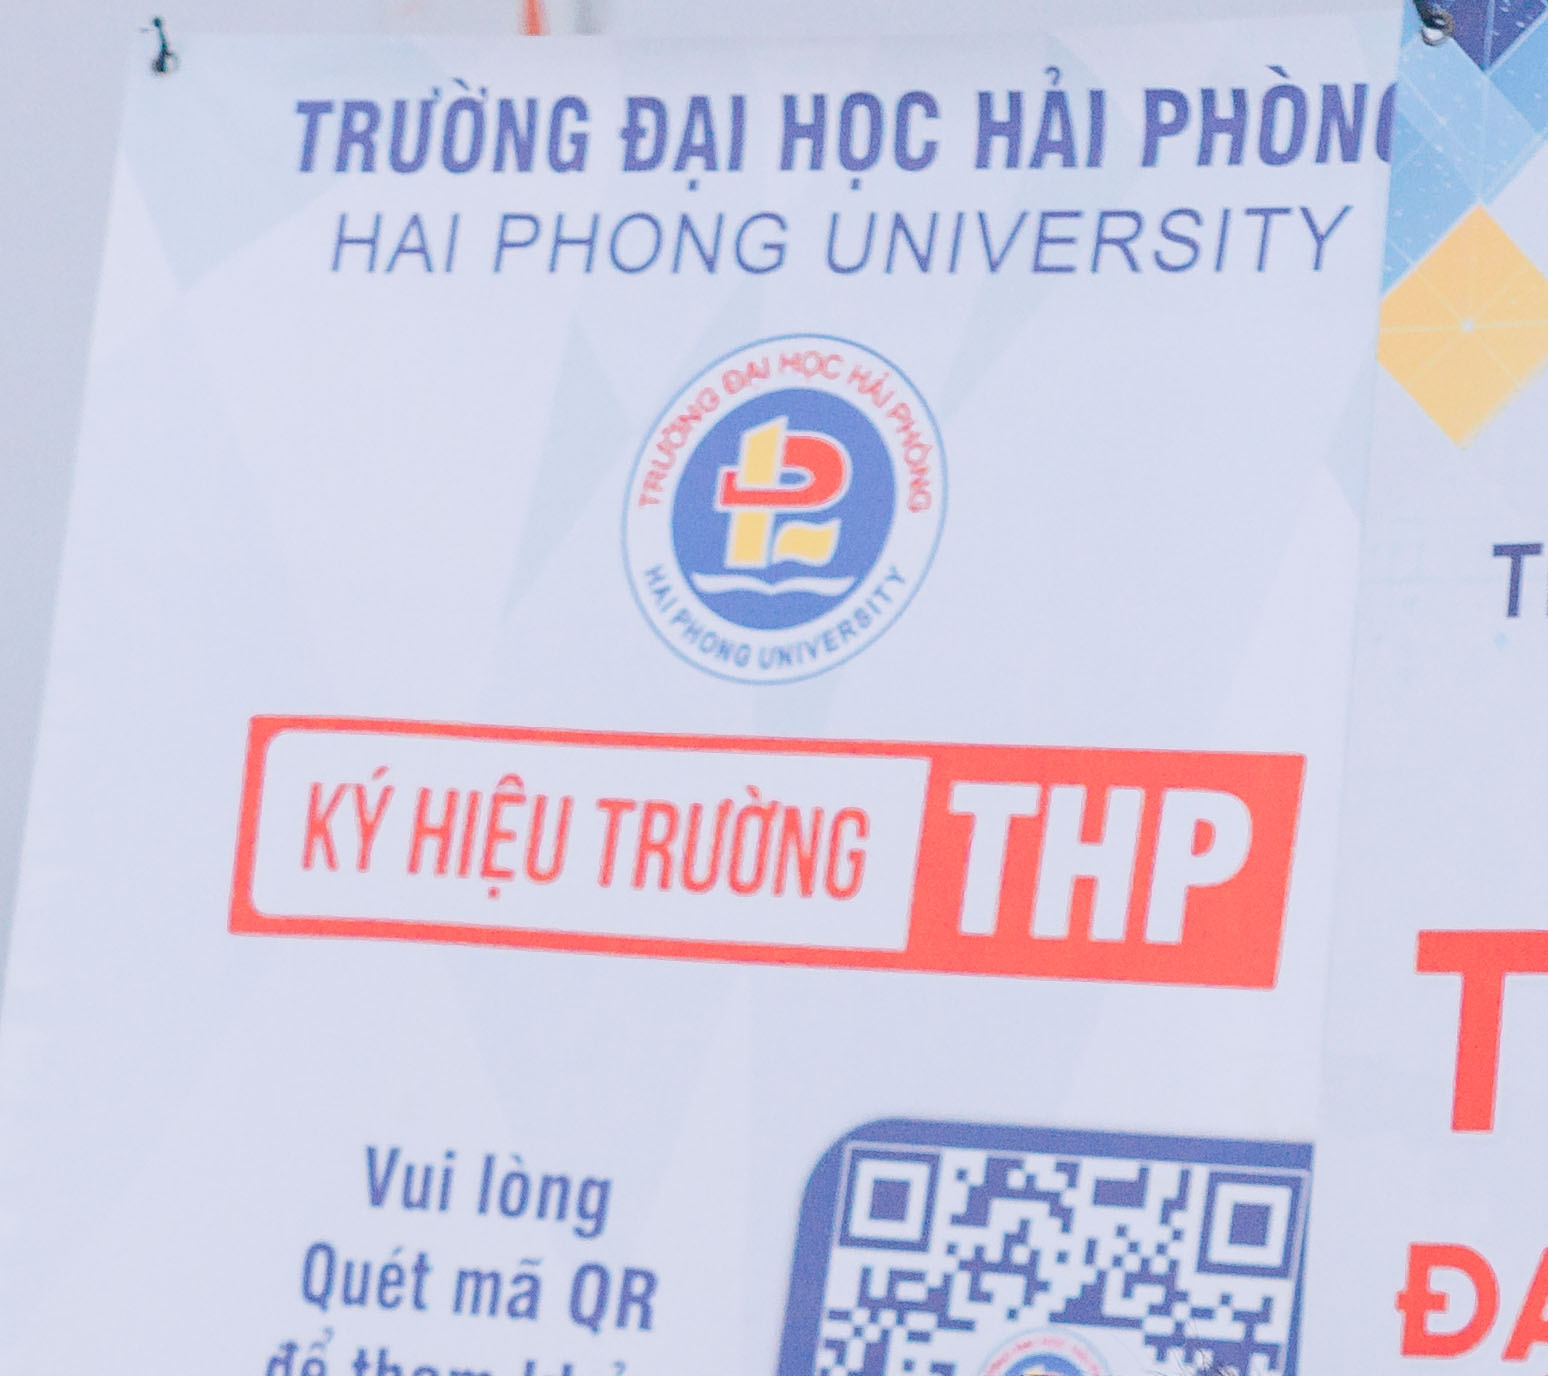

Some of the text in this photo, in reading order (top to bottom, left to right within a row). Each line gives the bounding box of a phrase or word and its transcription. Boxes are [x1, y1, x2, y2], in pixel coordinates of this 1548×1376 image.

[296, 78, 590, 174] TRƯỜNG
[620, 94, 747, 192] ĐẠI
[780, 90, 941, 191] HỌC
[975, 65, 1106, 170] HẢI
[331, 205, 1353, 275] HAI PHONG UNIVERSITY
[643, 563, 907, 671] HAI PHONG UNIVERSITY
[300, 766, 871, 900] KÝ HIỆU TRƯỜNG
[945, 782, 1254, 946] THP
[364, 1145, 612, 1240] Vui lòng
[301, 1241, 659, 1334] Quét mã QR
